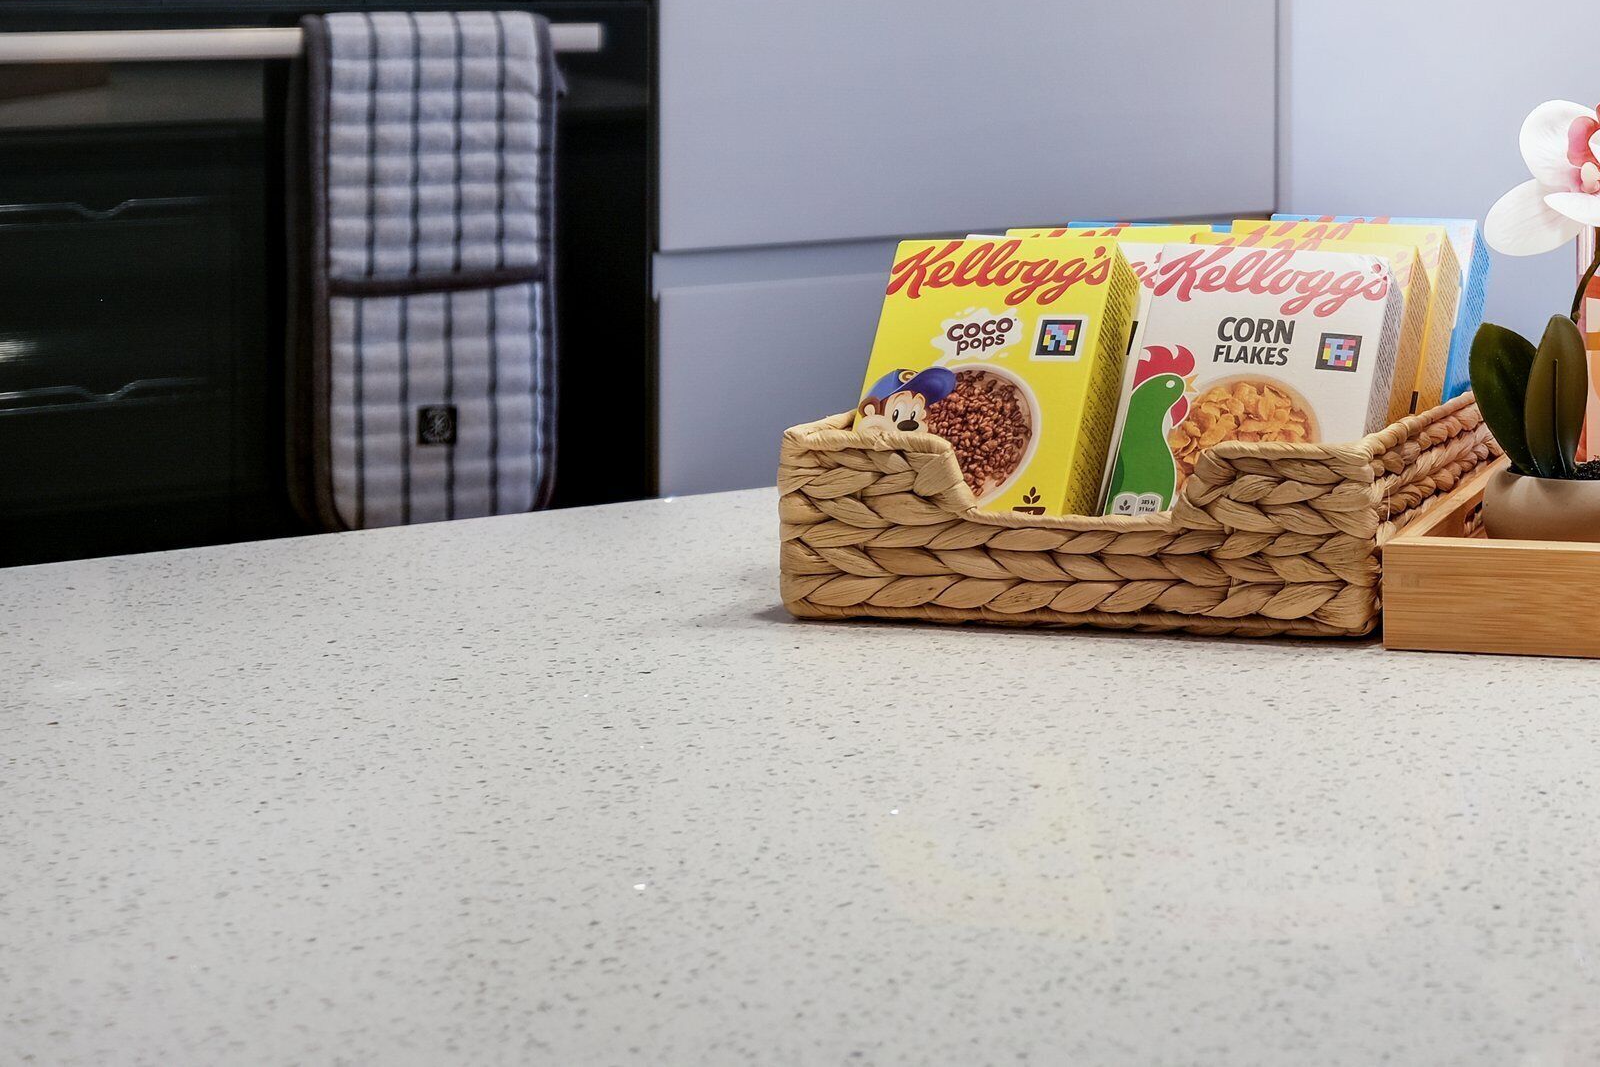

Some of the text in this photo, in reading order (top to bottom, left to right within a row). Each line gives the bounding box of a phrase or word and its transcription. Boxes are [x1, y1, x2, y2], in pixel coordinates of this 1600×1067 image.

[885, 239, 1111, 306] Kellogg's
[1153, 246, 1388, 318] Kellogg's
[956, 333, 1005, 355] pops
[1217, 316, 1296, 345] CORN
[1212, 344, 1290, 366] FLAKES
